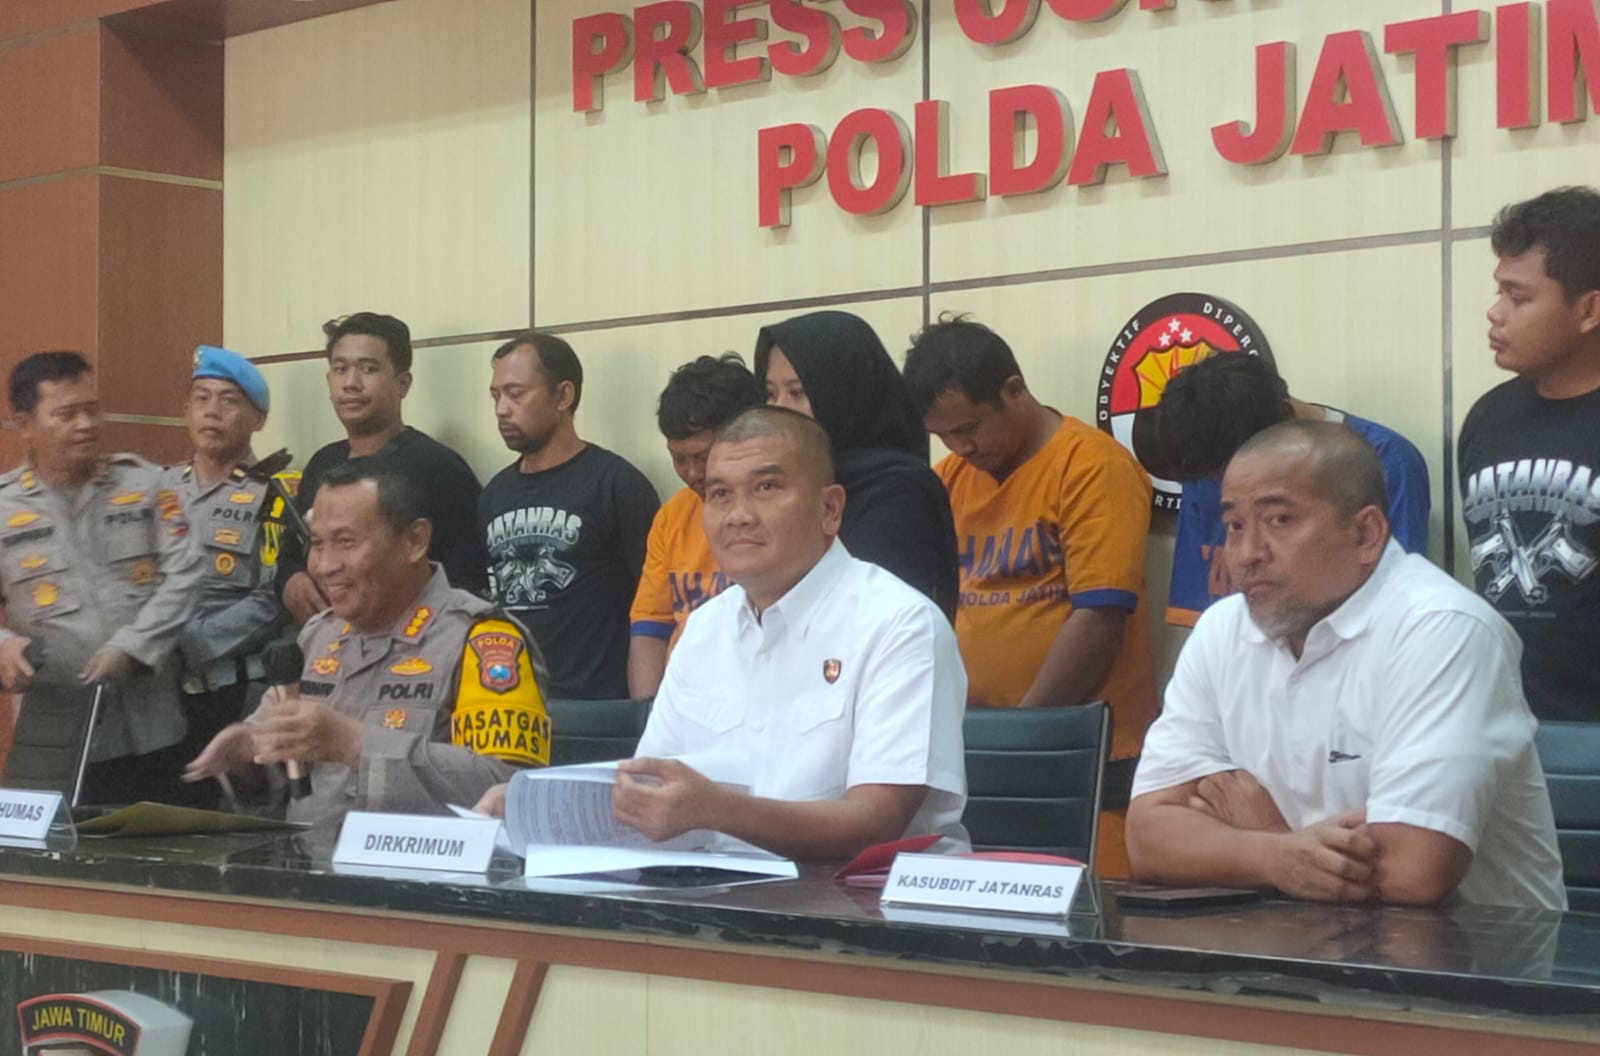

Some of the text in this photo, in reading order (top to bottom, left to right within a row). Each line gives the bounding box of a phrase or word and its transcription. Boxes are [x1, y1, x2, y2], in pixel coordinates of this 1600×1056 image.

[572, 0, 913, 113] PRESS
[757, 68, 1162, 227] POLDA
[478, 636, 515, 649] POLDA
[378, 682, 434, 701] POLRI
[453, 708, 549, 741] KASATGAS
[463, 730, 540, 755] HUMAS
[364, 833, 465, 857] DIRKRIMUM
[897, 874, 1064, 899] KASUBDIT JATANRAS
[32, 1006, 126, 1047] JAWA TIMUR
